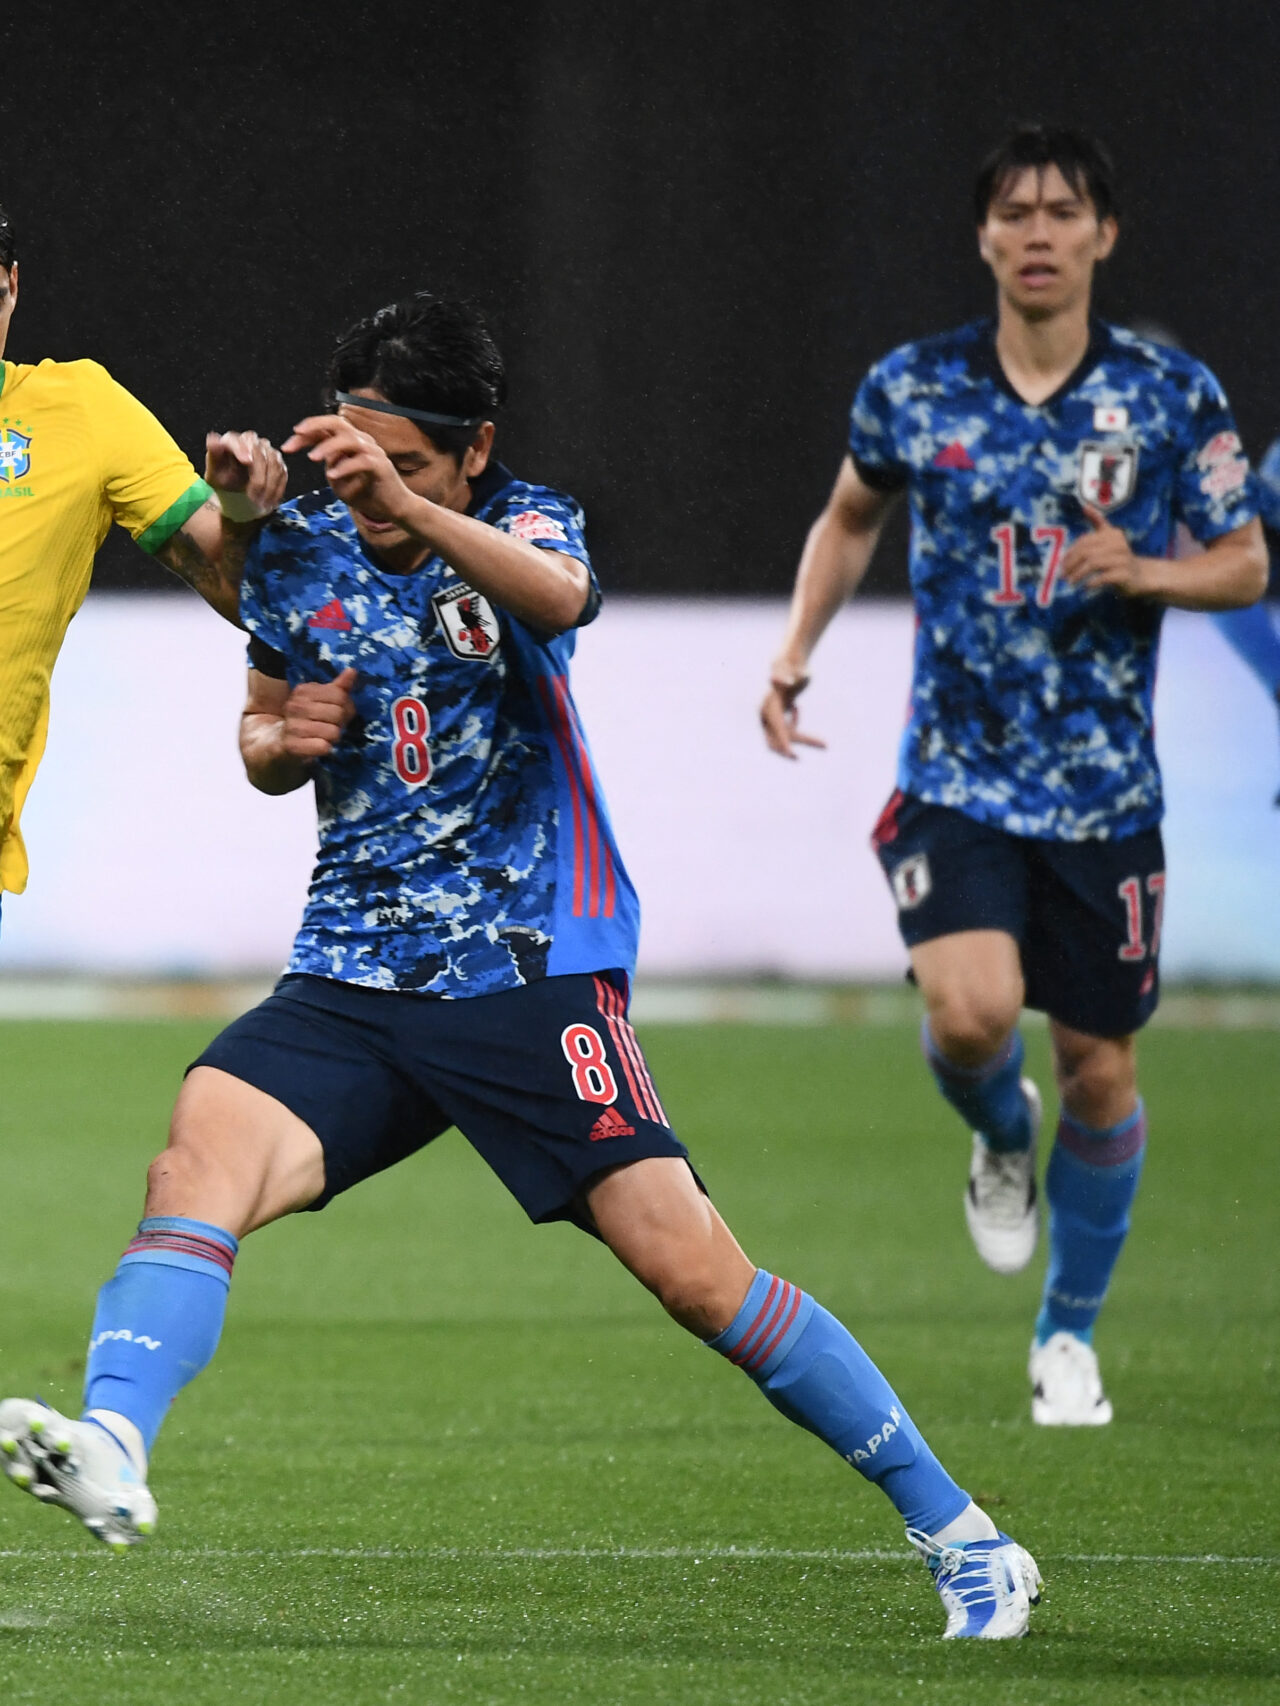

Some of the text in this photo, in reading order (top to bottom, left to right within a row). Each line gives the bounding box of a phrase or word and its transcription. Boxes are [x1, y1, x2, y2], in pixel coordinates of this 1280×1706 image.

[984, 523, 1066, 608] 17
[391, 696, 433, 786] 8
[1118, 872, 1166, 960] 17
[561, 1023, 619, 1105] 8
